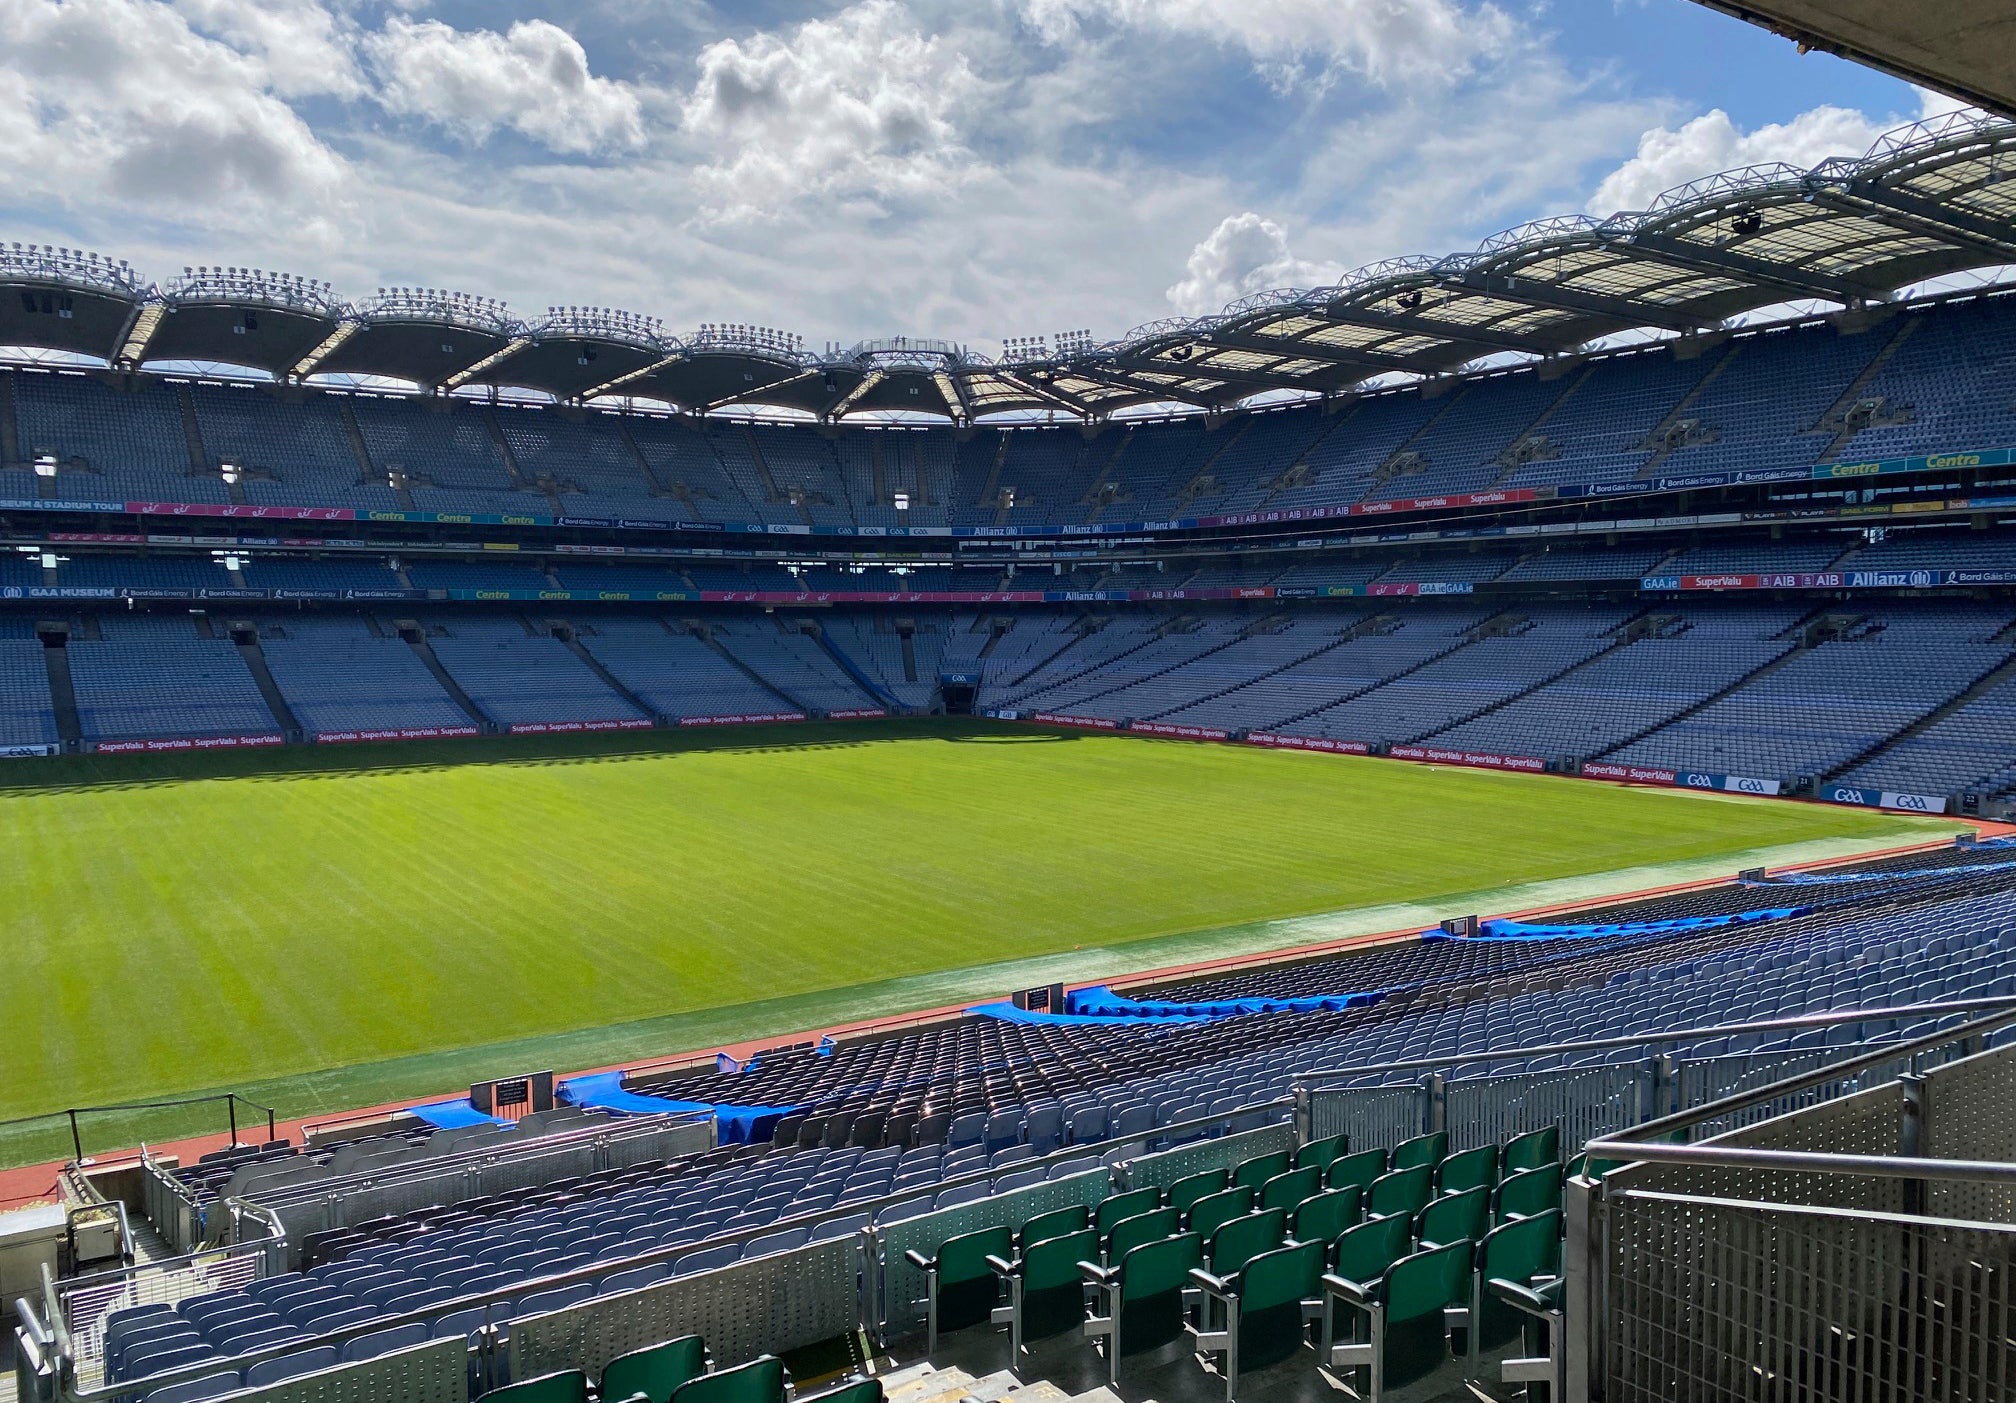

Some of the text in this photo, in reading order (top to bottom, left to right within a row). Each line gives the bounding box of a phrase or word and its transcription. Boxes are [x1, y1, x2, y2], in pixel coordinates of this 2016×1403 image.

[1926, 454, 1980, 468] Centra
[1832, 462, 1880, 476] Centra
[1746, 470, 1808, 481] Bord Gáis Energy
[1668, 476, 1724, 487] Bord Gáis Energy
[1596, 482, 1649, 493] Bord Gáis Energy
[1414, 498, 1447, 509] SuperValu
[1470, 494, 1506, 504] SuperValu
[34, 500, 42, 509] &
[44, 501, 92, 510] STADIUM
[94, 502, 123, 511] TOUR
[1336, 506, 1350, 515] AIB
[1362, 503, 1392, 513] SuperValu
[369, 512, 405, 521] Centra
[1266, 512, 1279, 521] AIB
[1288, 510, 1301, 519] AIB
[1312, 508, 1325, 517] AIB
[437, 514, 471, 523] Centra
[502, 516, 535, 525] Centra
[1226, 516, 1238, 525] AIB
[1246, 514, 1257, 523] AIB
[1062, 525, 1091, 534] Allianz
[1143, 522, 1169, 530] Allianz
[974, 527, 1005, 536] Allianz
[1696, 576, 1742, 587] SuperValu
[1774, 576, 1796, 587] AIB
[1816, 575, 1839, 586] AIB
[1853, 573, 1907, 586] Allianz
[1960, 573, 1982, 581] Bord
[1982, 572, 2003, 581] Gáis
[1420, 584, 1446, 593] GAA.ie
[1447, 583, 1474, 593] GAA.ie
[1644, 578, 1678, 589] GAA.ie
[31, 588, 114, 597] GAA MUSEUM
[164, 590, 188, 598] Energy
[476, 591, 510, 599] Centra
[539, 591, 571, 599] Centra
[599, 592, 630, 600] Centra
[657, 592, 686, 600] Centra
[1065, 592, 1094, 600] Allianz
[1152, 591, 1163, 599] AIB
[1173, 590, 1185, 598] AIB
[1240, 589, 1265, 597] SuperValu
[1328, 587, 1354, 595] Centra
[952, 674, 967, 682] GAA
[776, 713, 804, 721] SuperValu
[830, 710, 857, 718] SuperValu
[858, 709, 885, 717] SuperValu
[620, 719, 652, 728] SuperValu
[680, 717, 712, 725] SuperValu
[713, 715, 743, 724] SuperValu
[745, 714, 775, 723] SuperValu
[512, 724, 547, 733] SuperValu
[549, 722, 582, 731] SuperValu
[584, 721, 618, 730] SuperValu
[1132, 722, 1154, 732] SuperValu
[1154, 724, 1176, 733] SuperValu
[361, 730, 398, 740] SuperValu
[401, 728, 438, 738] SuperValu
[441, 726, 477, 736] SuperValu
[1177, 726, 1201, 736] SuperValu
[1202, 728, 1226, 738] SuperValu
[240, 736, 282, 745] SuperValu
[318, 732, 357, 742] SuperValu
[1248, 732, 1275, 743] SuperValu
[1276, 736, 1303, 746] SuperValu
[99, 742, 144, 752] SuperValu
[148, 740, 191, 750] SuperValu
[195, 737, 237, 748] SuperValu
[1305, 738, 1334, 749] SuperValu
[1336, 741, 1367, 751] SuperValu
[1391, 746, 1425, 757] SuperValu
[1427, 750, 1462, 761] SuperValu
[1465, 754, 1502, 765] SuperValu
[1504, 758, 1543, 769] SuperValu
[1584, 763, 1627, 776] SuperValu
[1630, 768, 1674, 781] SuperValu
[1688, 774, 1713, 788] GAA
[1738, 778, 1764, 793] GAA
[1834, 788, 1865, 804] GAA
[1896, 795, 1928, 810] GAA
